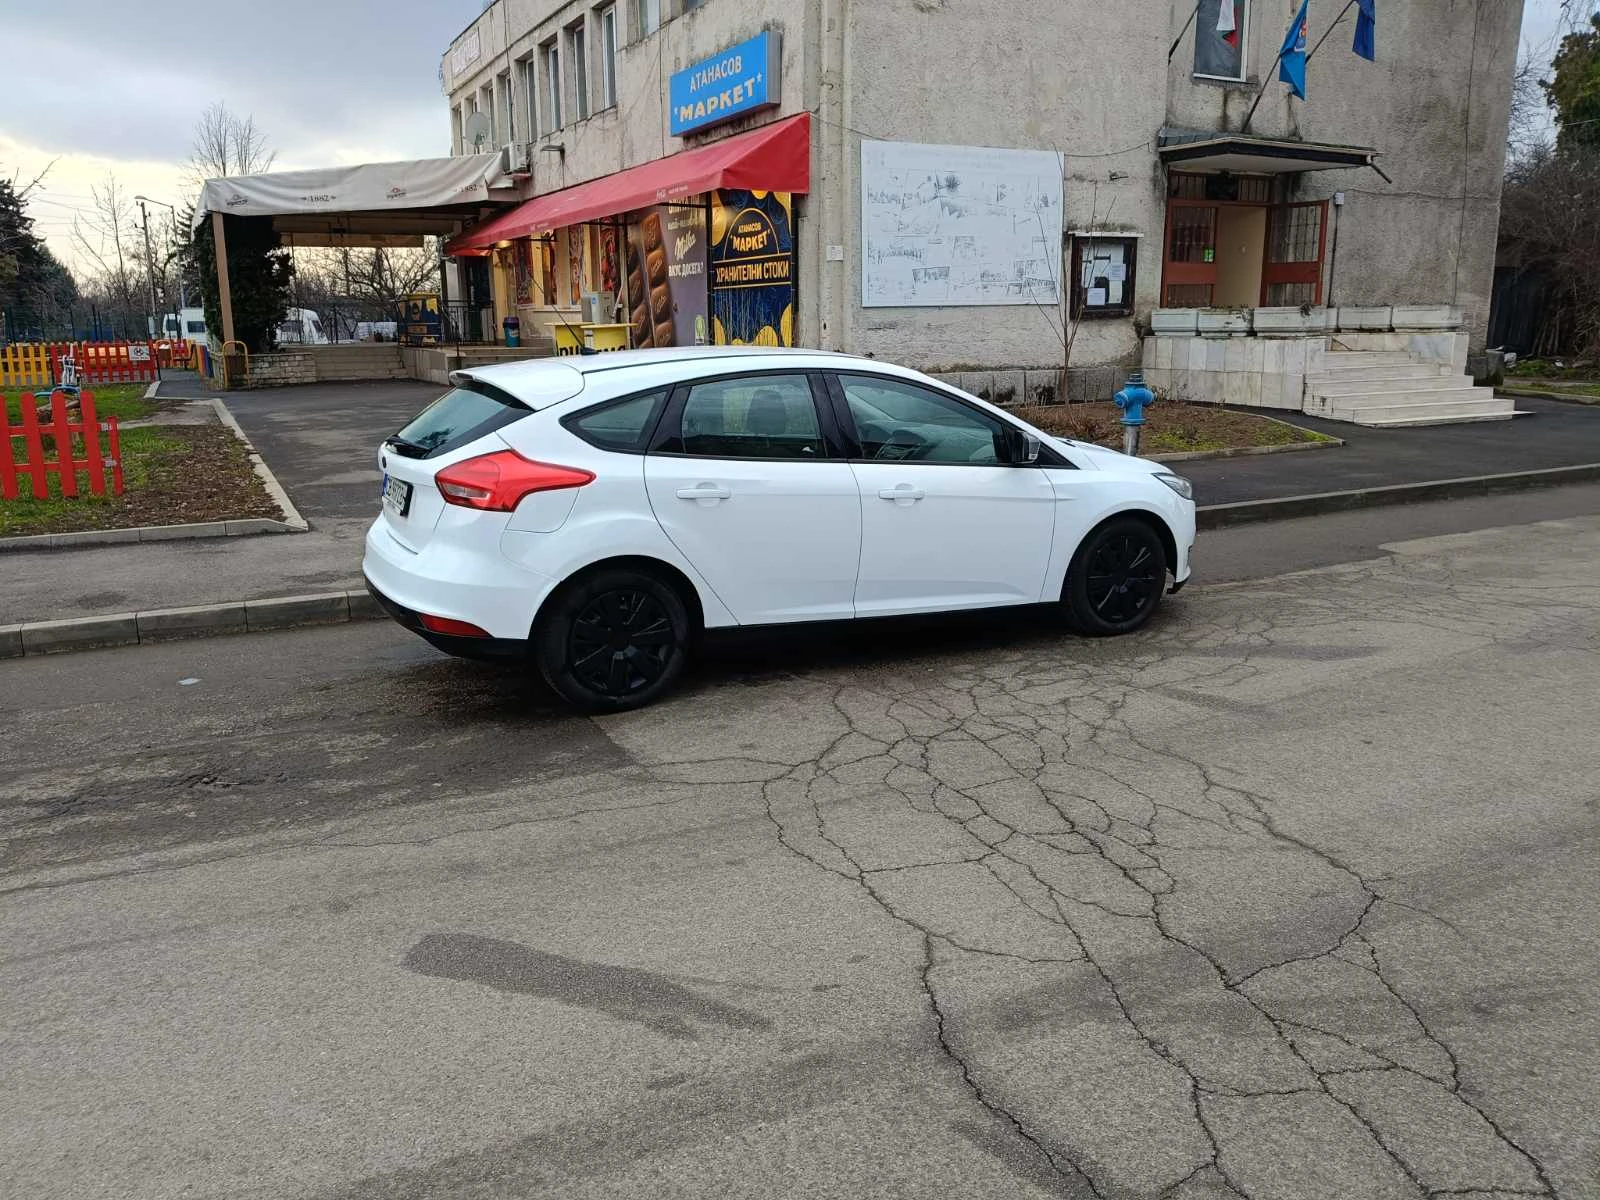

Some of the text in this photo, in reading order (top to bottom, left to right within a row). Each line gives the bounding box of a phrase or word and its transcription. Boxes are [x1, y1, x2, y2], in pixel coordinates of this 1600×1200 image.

[690, 56, 742, 93] АТАНАСОВ
[680, 78, 755, 122] МАРКЕТ
[738, 222, 762, 233] АТАНАСОВ
[674, 230, 697, 261] Milka
[732, 231, 769, 252] МАРКЕТ
[668, 264, 682, 277] ВКУС
[716, 260, 789, 283] ХРАНИТЕЛНИ СТОКИ
